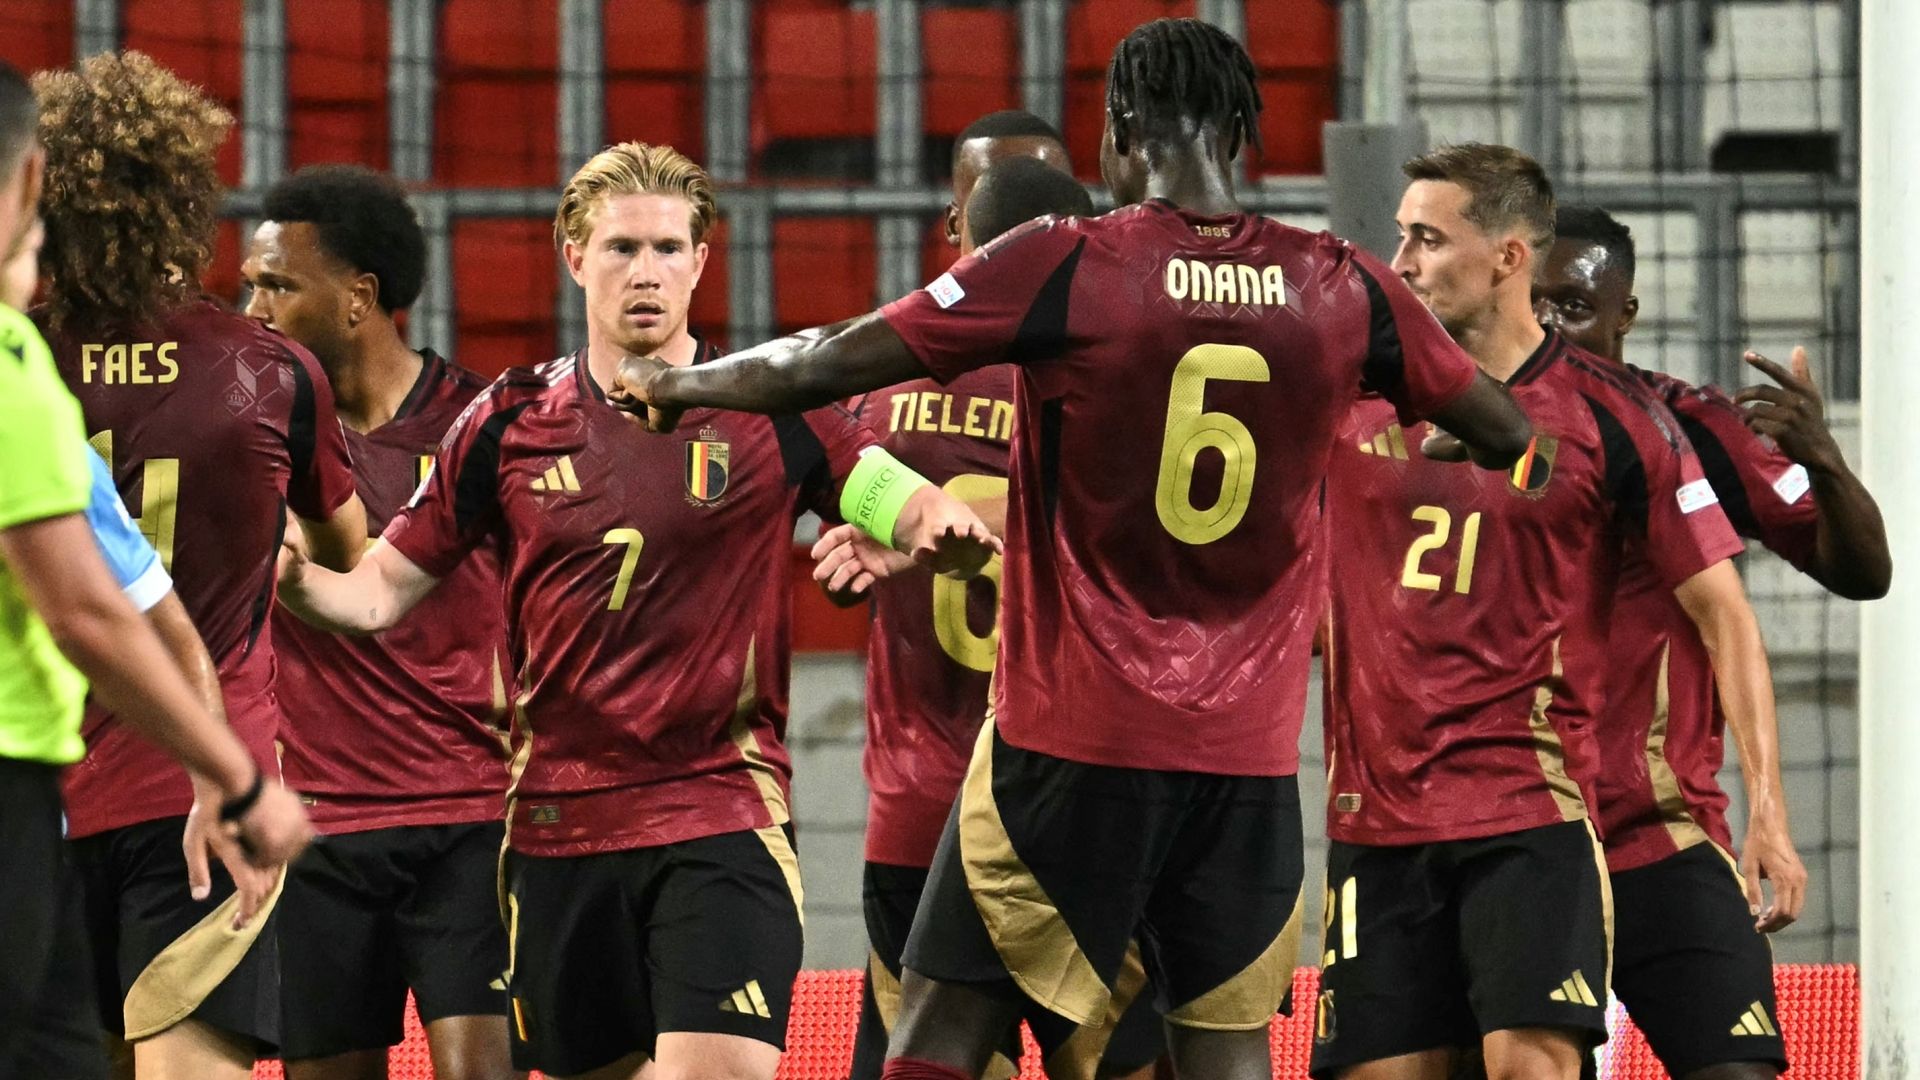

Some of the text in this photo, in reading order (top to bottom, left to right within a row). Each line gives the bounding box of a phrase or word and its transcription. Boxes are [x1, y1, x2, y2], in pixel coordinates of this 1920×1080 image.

[1167, 258, 1286, 305] ONANA
[82, 341, 179, 384] FAES
[1155, 343, 1271, 546] 6
[860, 468, 896, 521] RESPECT
[603, 527, 645, 611] 7
[1401, 505, 1481, 594] 21
